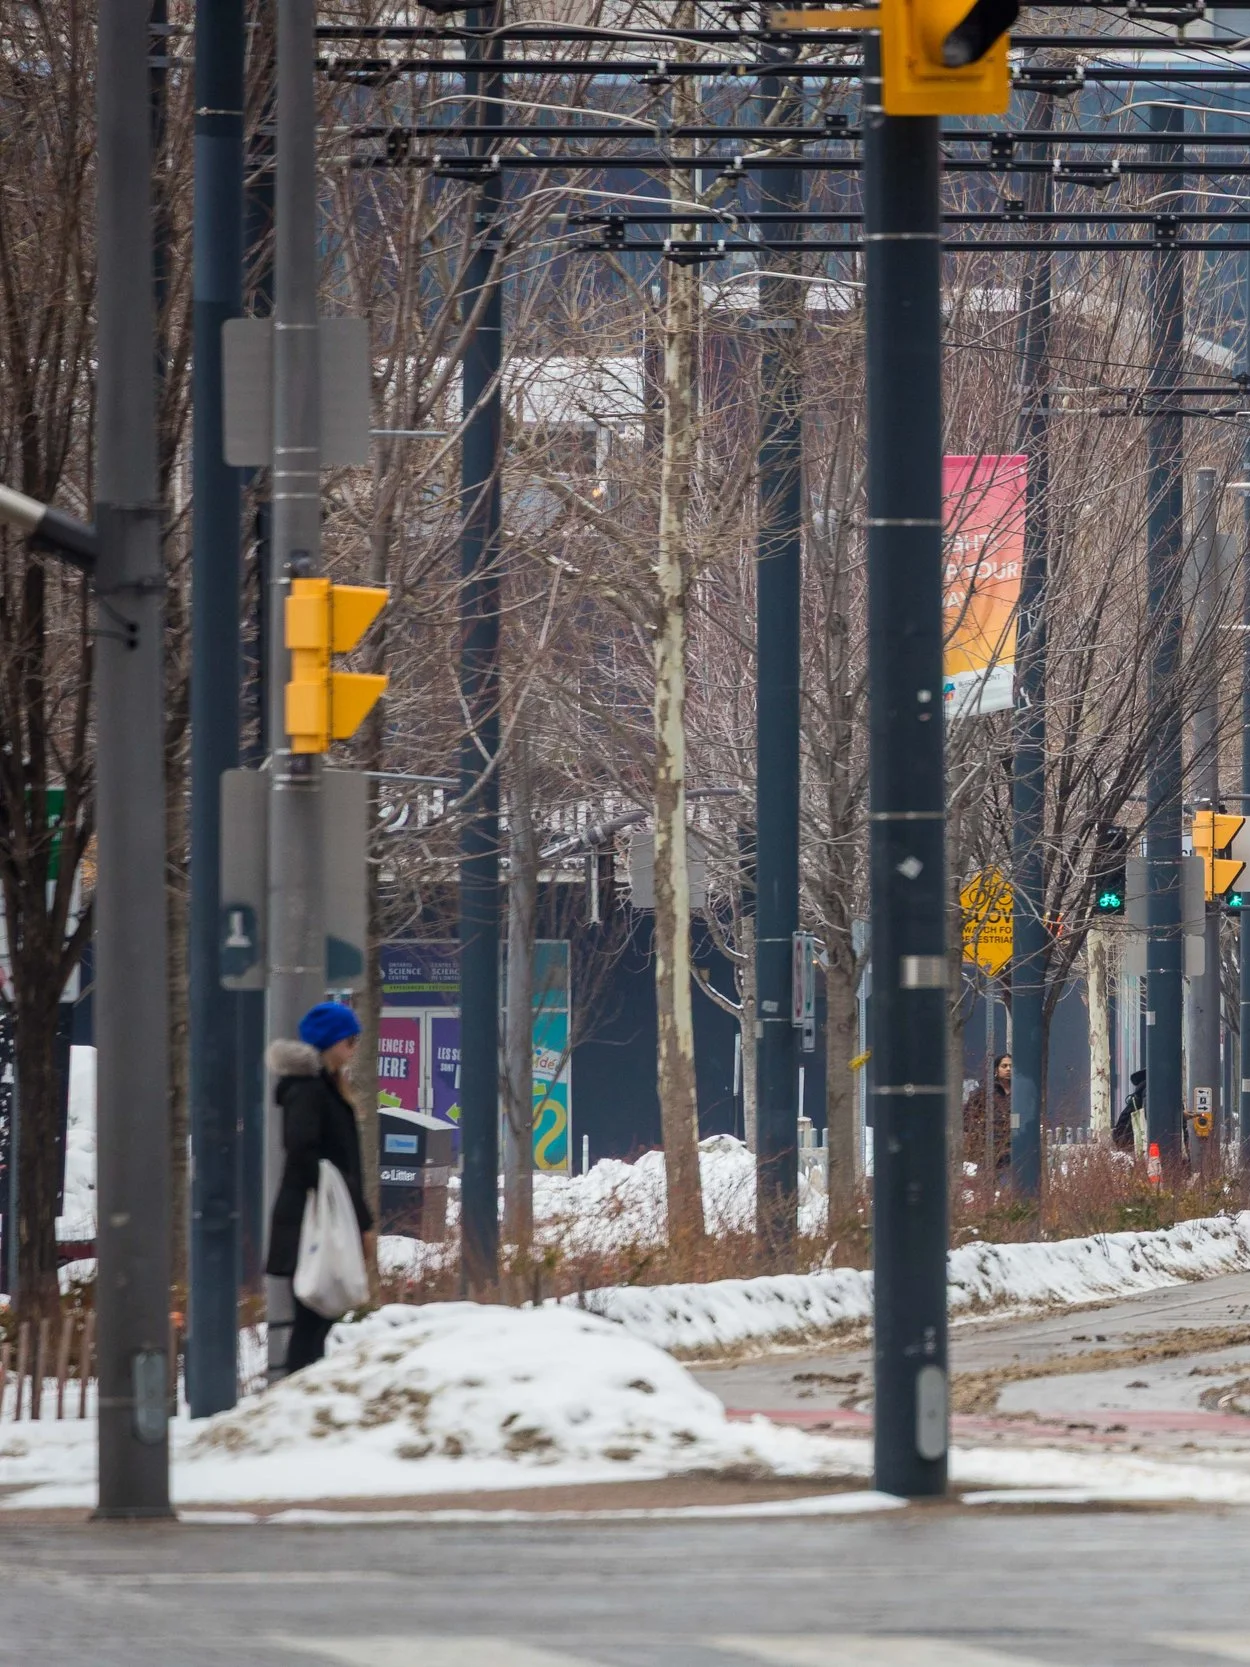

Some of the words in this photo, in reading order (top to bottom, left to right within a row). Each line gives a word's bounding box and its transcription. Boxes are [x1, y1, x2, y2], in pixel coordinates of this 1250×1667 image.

[965, 561, 1019, 579] YOUR
[405, 1040, 415, 1054] IS
[437, 1048, 451, 1060] LES
[391, 1168, 416, 1181] Litter
